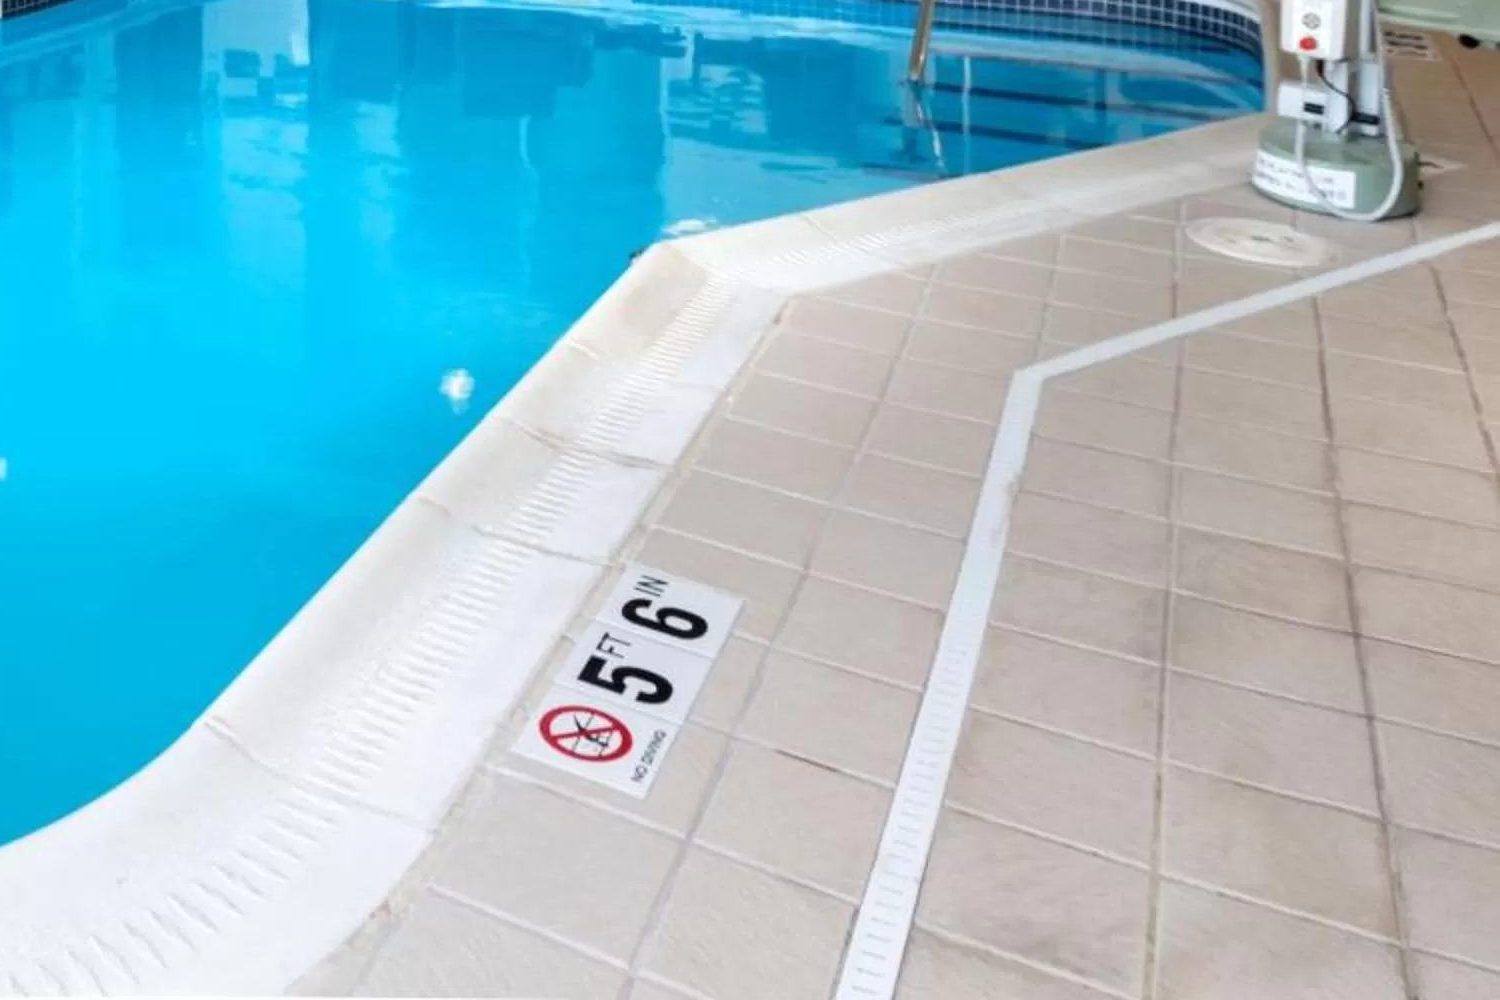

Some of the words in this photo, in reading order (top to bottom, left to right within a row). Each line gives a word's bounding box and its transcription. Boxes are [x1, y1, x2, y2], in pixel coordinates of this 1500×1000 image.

[632, 574, 669, 597] IN
[621, 597, 708, 640] 6
[596, 632, 632, 659] FT
[576, 654, 673, 705] 5
[630, 764, 649, 782] NO
[641, 729, 667, 767] DIVING
